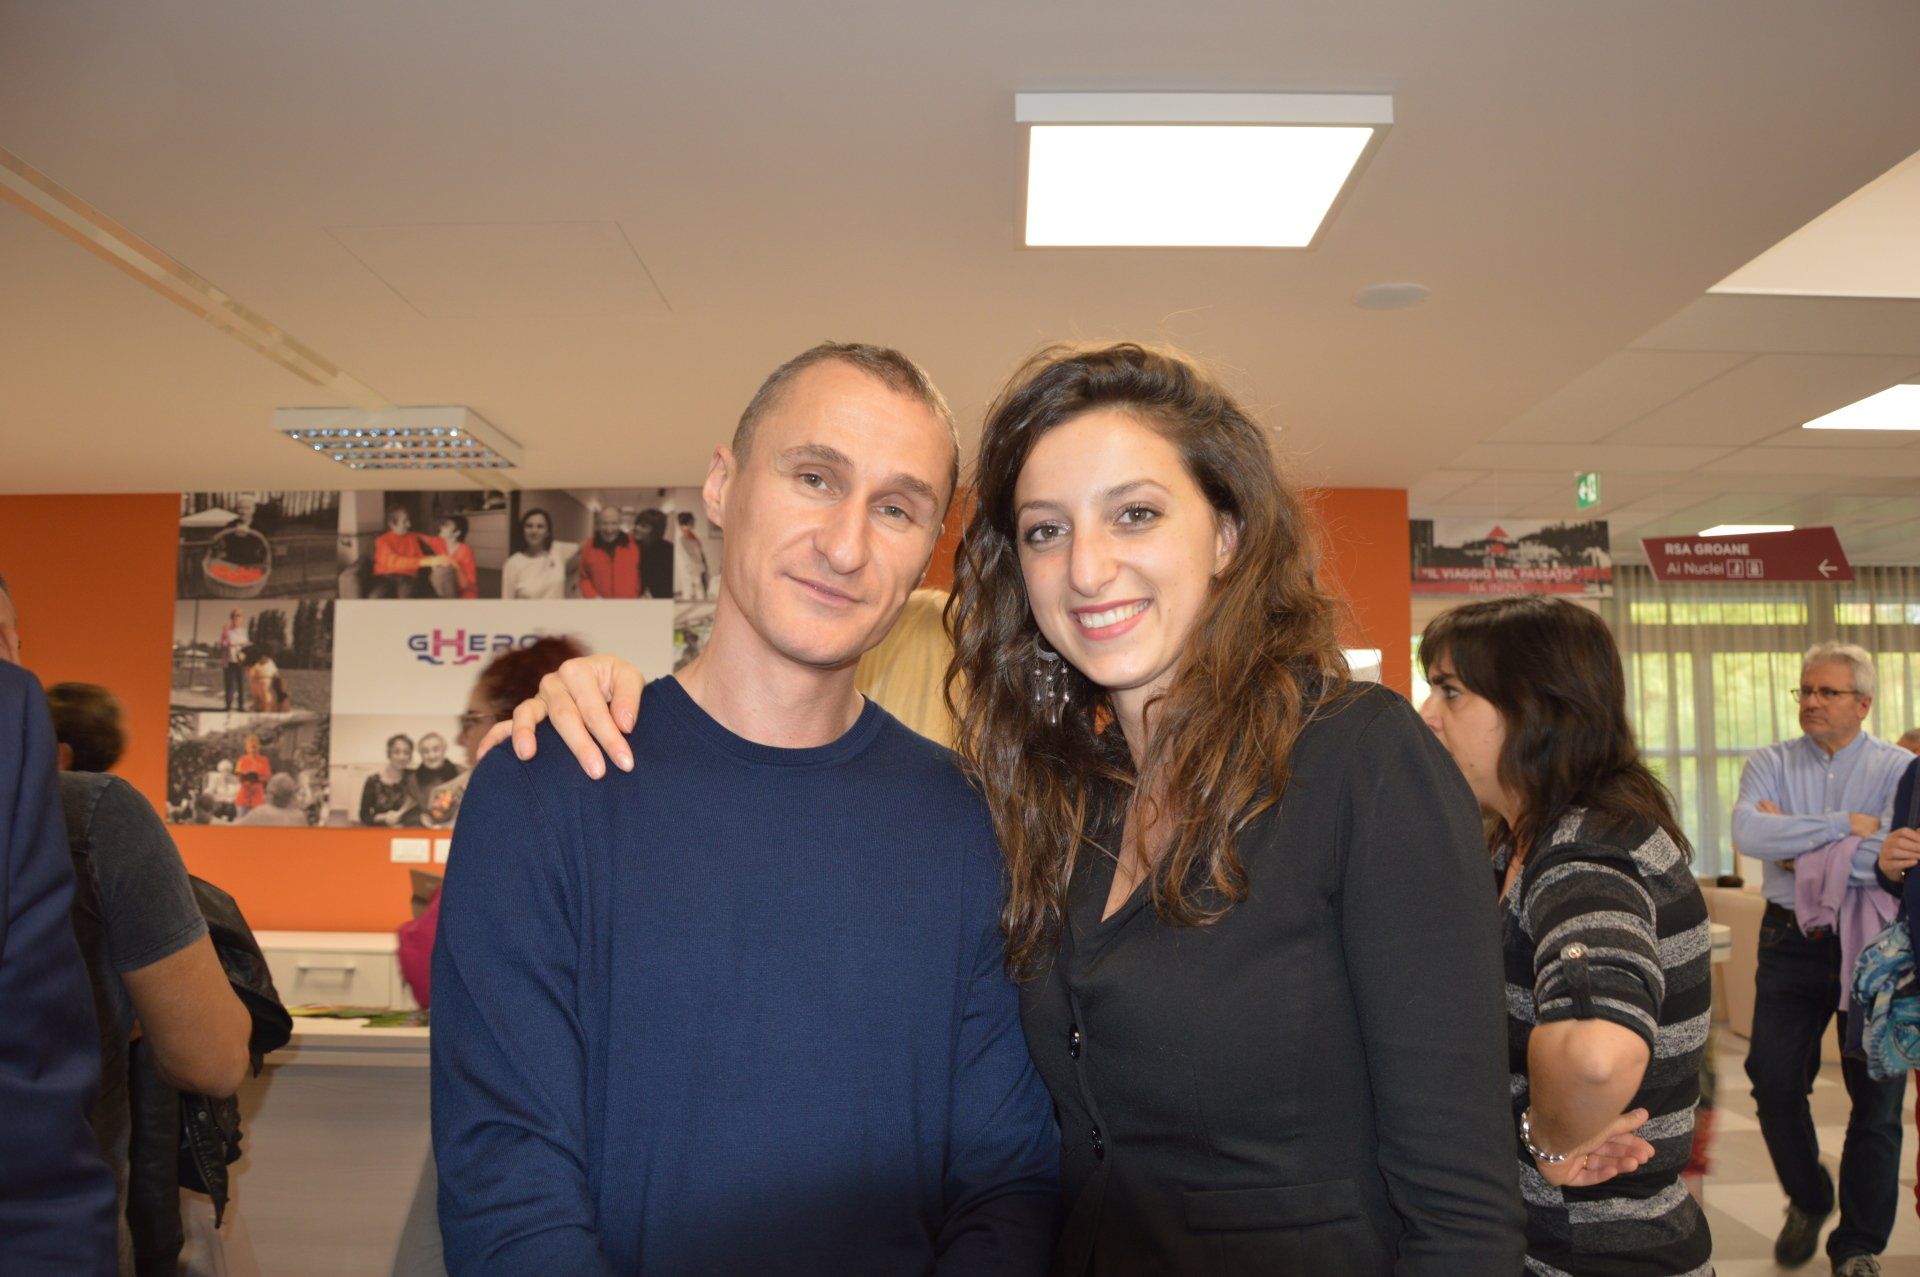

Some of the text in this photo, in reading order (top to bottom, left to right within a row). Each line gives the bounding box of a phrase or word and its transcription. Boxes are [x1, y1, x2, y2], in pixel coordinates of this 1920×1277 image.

[1664, 543, 1750, 556] RSA GROANE
[1441, 568, 1491, 579] VIAGGIO
[1495, 568, 1517, 579] NEL
[1667, 561, 1724, 575] Ai Nuclei
